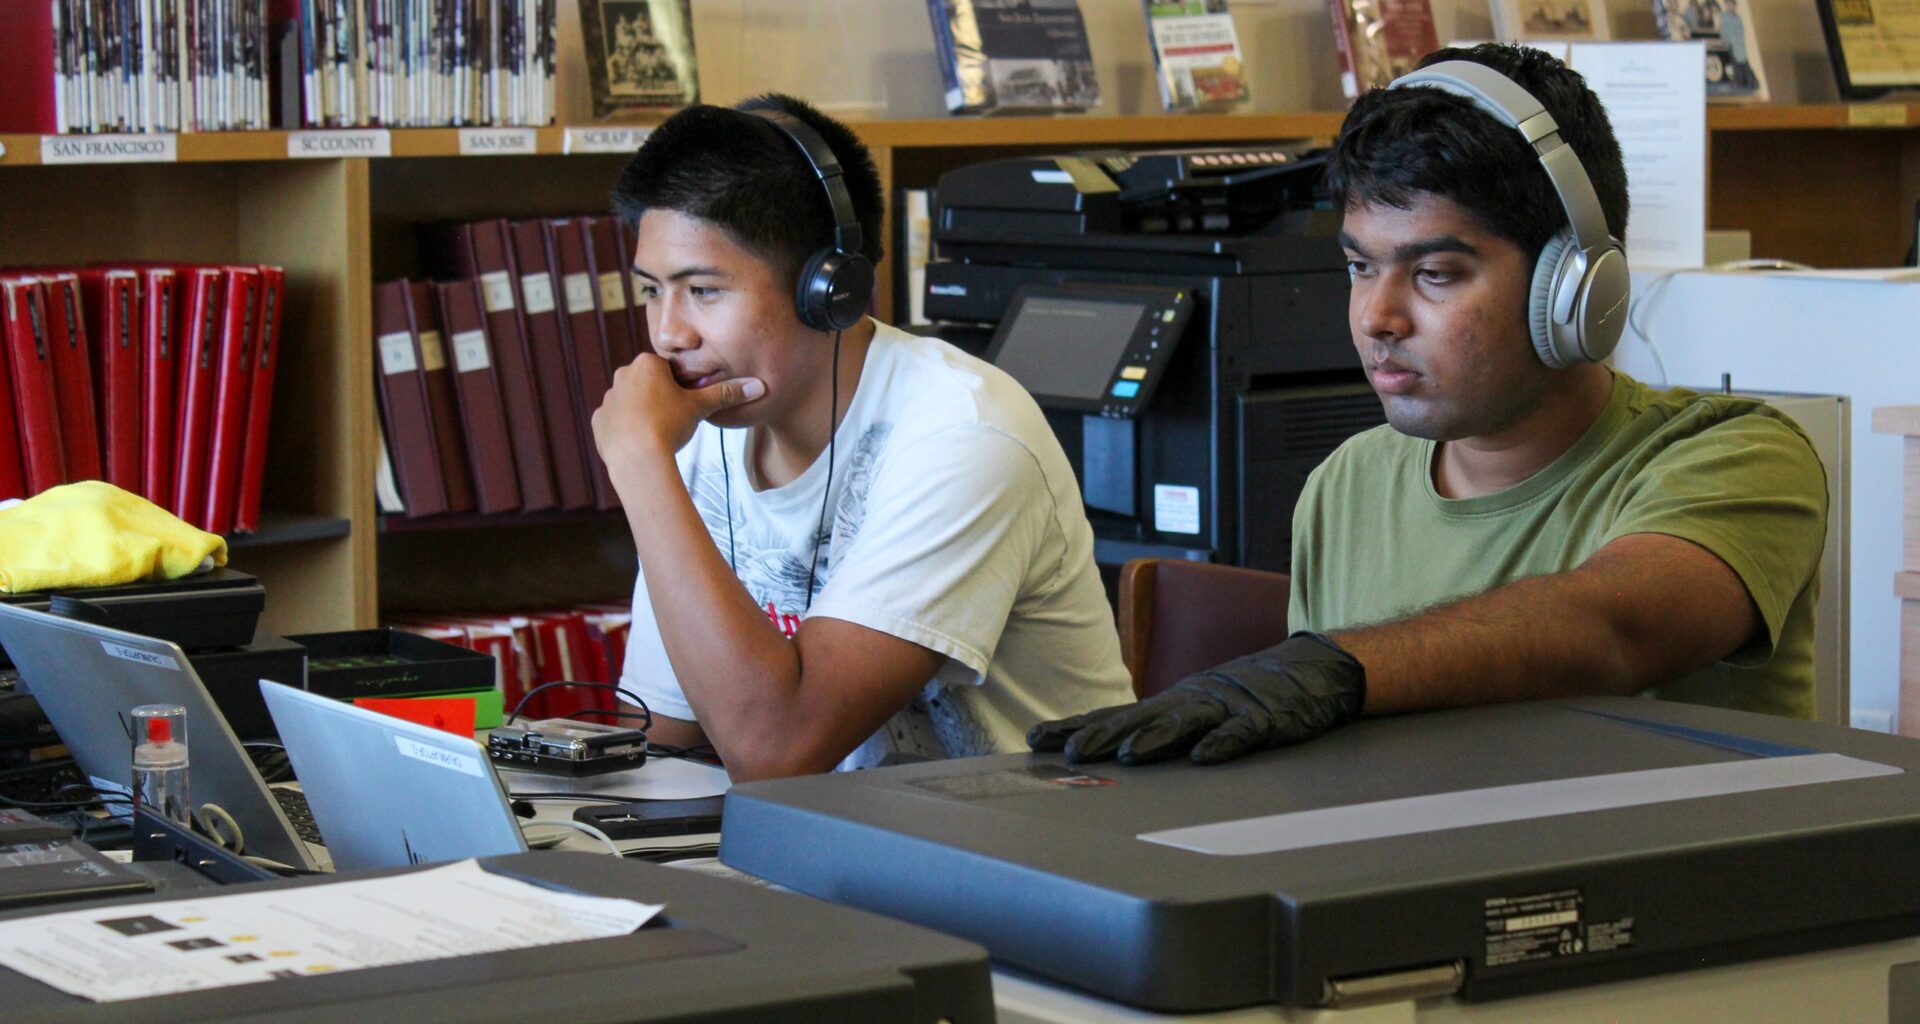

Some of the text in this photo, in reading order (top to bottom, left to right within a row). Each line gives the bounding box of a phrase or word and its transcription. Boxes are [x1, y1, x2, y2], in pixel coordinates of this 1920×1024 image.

[302, 136, 376, 151] SC COUNTY
[470, 134, 526, 149] SAN JOSE
[583, 130, 629, 146] SCRAP
[53, 140, 165, 156] SAN FRANCISCO
